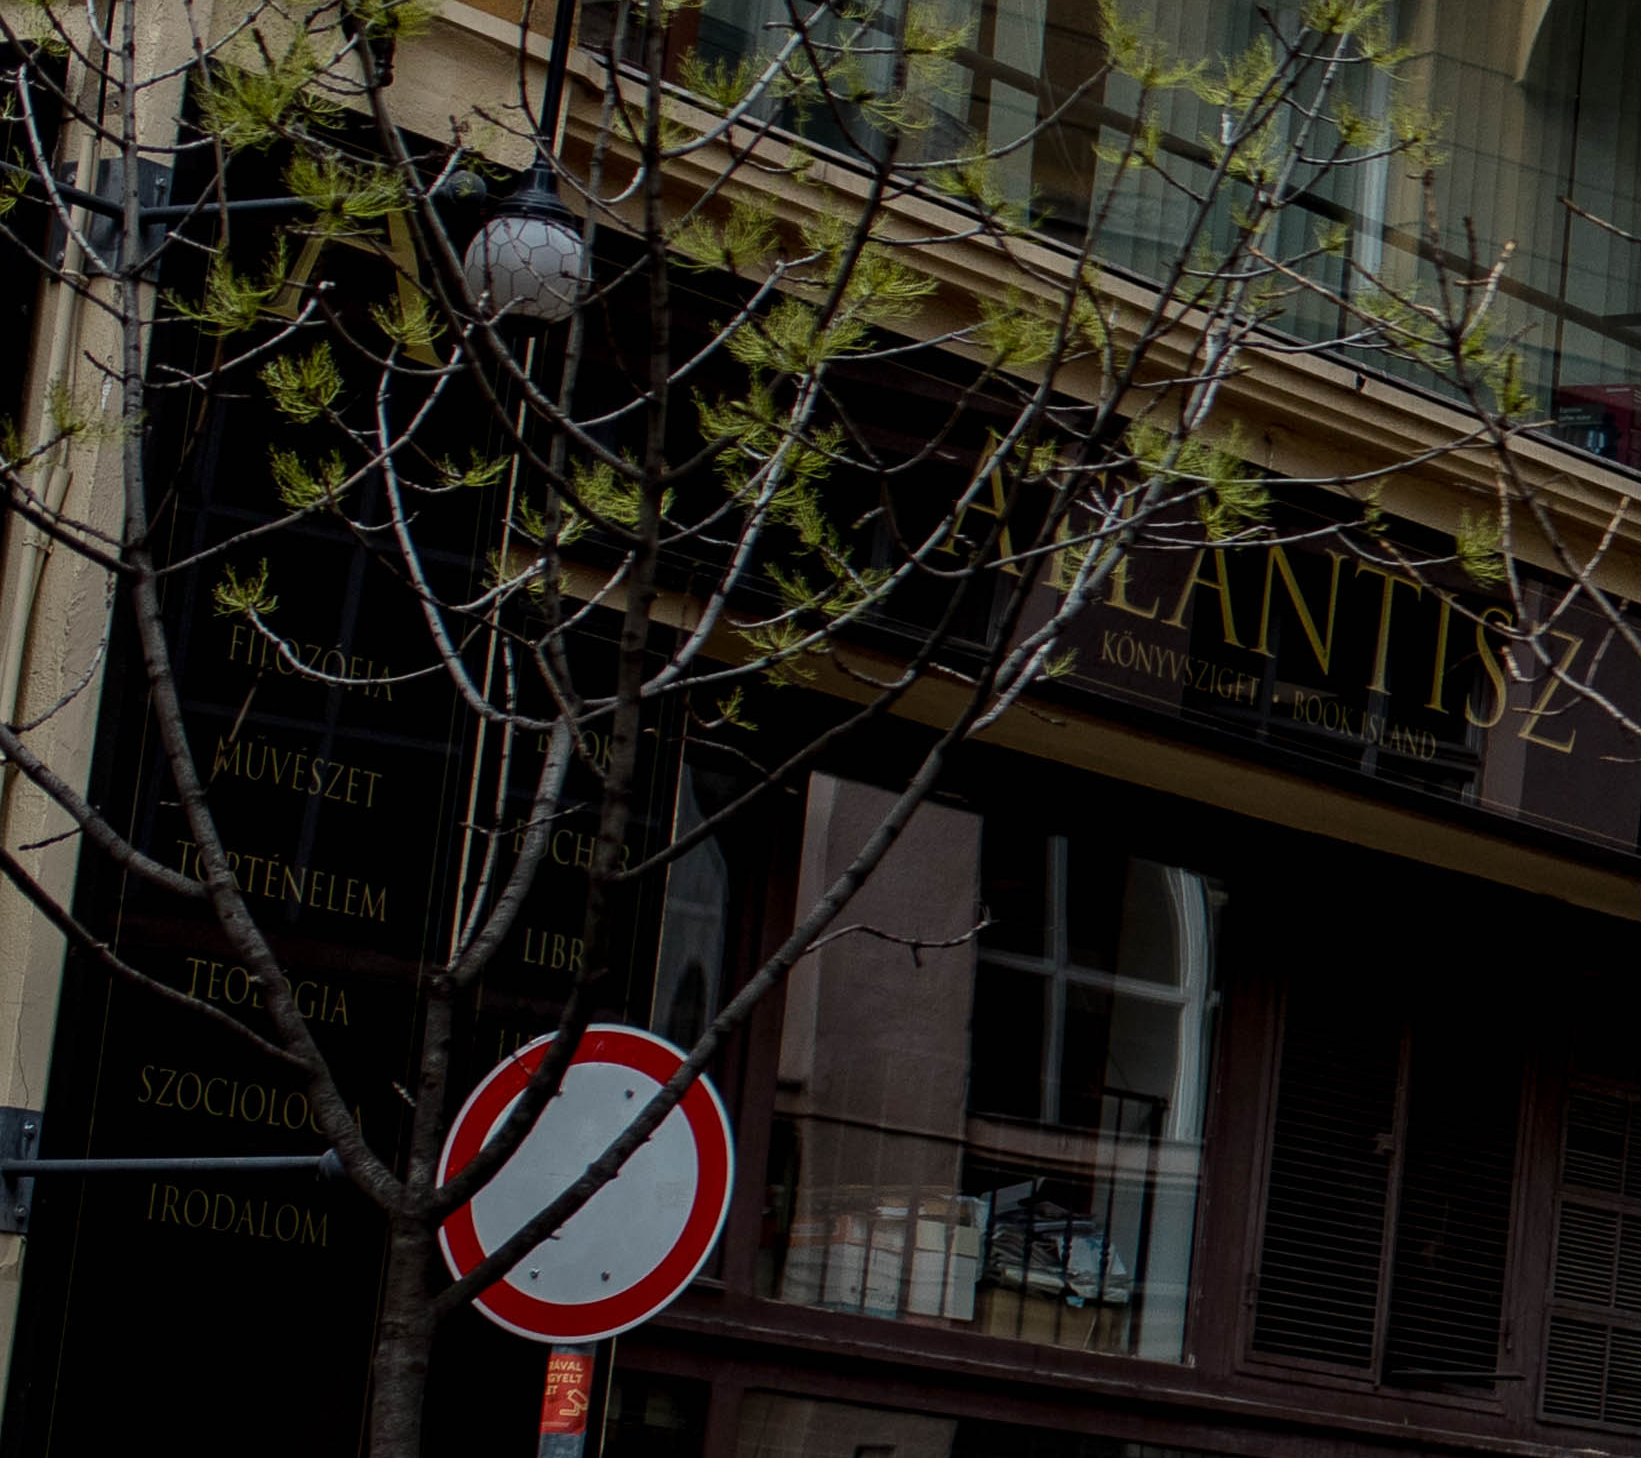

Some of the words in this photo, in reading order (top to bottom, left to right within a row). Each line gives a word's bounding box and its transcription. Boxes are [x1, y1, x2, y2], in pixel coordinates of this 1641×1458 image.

[1100, 629, 1261, 705] KÖNYVSZIGET
[1292, 691, 1354, 738] BOOK
[1360, 712, 1438, 763] ISLAND
[144, 1180, 329, 1248] IRODALOM
